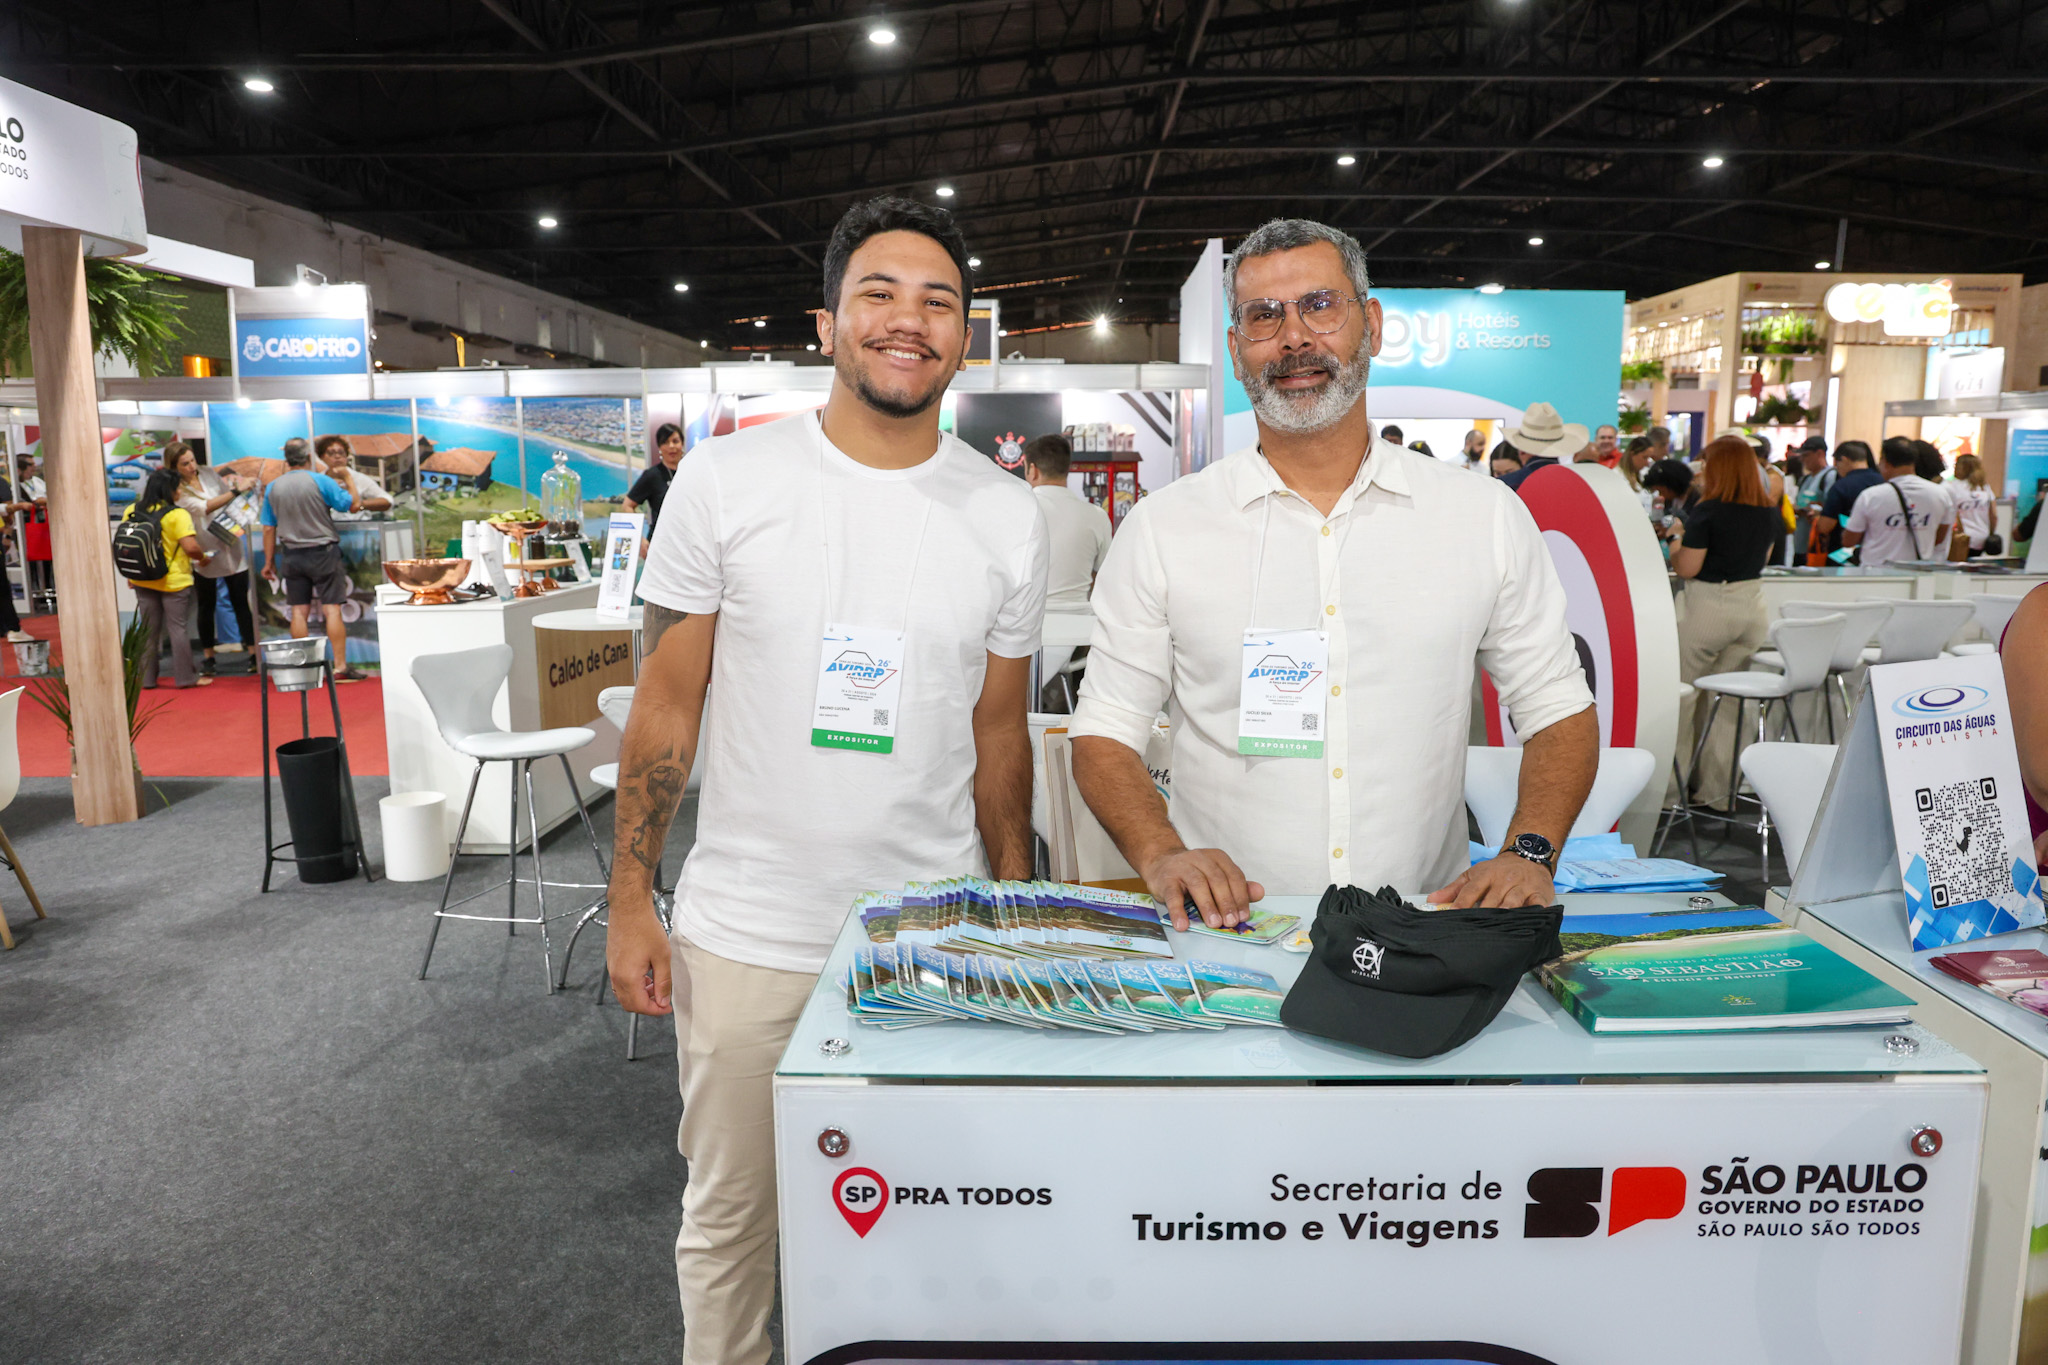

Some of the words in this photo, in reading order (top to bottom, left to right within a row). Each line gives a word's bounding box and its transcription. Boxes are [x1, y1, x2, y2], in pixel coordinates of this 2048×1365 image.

[1458, 312, 1520, 329] Hotéis
[1456, 332, 1471, 349] &
[1475, 332, 1551, 349] Resorts
[549, 656, 584, 688] Caldo
[587, 649, 600, 673] de
[603, 642, 629, 666] Cana
[1896, 722, 1941, 740] CIRCUITO
[1943, 719, 1962, 733] DAS
[1965, 714, 1996, 730] ÁGUAS
[827, 734, 879, 745] EXPOSITOR
[1254, 741, 1308, 750] EXPOSITOR
[1898, 728, 1998, 750] PAULISTA
[1649, 959, 1803, 975] SEBASTIÃO
[1221, 1003, 1242, 1011] Guia
[1701, 1156, 1786, 1195] SÃO
[1796, 1163, 1928, 1194] PAULO
[1270, 1173, 1446, 1201] Secretaria
[1461, 1170, 1502, 1200] de
[845, 1186, 877, 1203] SP
[895, 1187, 949, 1205] PRA
[957, 1187, 1052, 1206] TODOS
[1699, 1200, 1801, 1214] GOVERNO
[1809, 1200, 1838, 1213] DO
[1846, 1199, 1924, 1213] ESTADO
[1132, 1212, 1287, 1241] Turismo
[1302, 1220, 1324, 1241] e
[1339, 1211, 1499, 1248] Viagens
[1698, 1221, 1735, 1237] SÃO
[1744, 1222, 1802, 1237] PAULO
[1811, 1220, 1849, 1236] SÃO
[1858, 1222, 1920, 1235] TODOS
